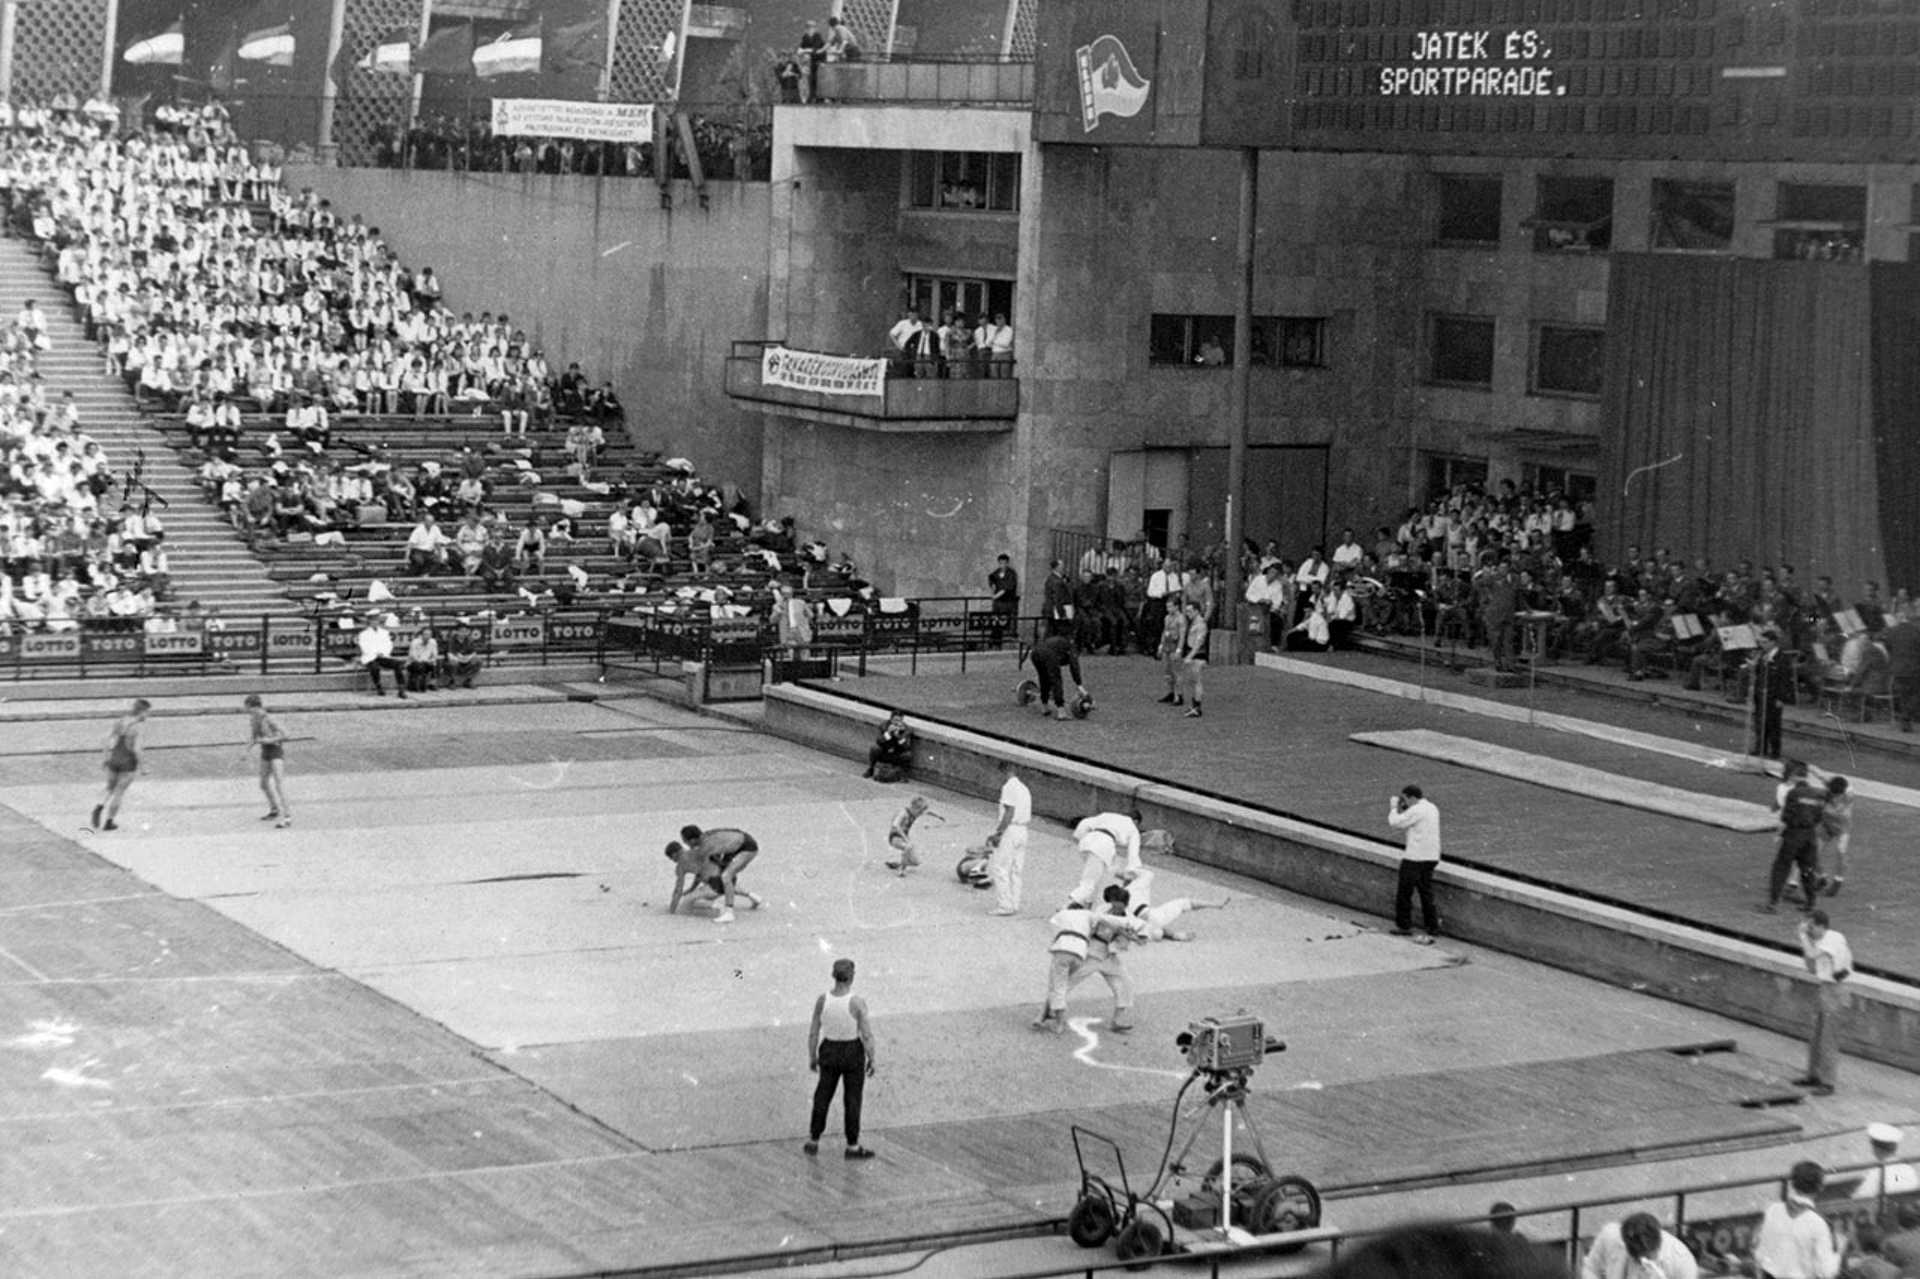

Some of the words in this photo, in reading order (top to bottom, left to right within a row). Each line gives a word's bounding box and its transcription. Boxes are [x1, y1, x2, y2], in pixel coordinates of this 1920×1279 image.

[873, 617, 911, 629] TOTO
[494, 627, 540, 639] LOTTO
[553, 626, 594, 638] TOTO
[25, 639, 76, 652] LOTTO
[91, 638, 136, 651] TOTO
[150, 637, 198, 650] LOTTO
[212, 636, 256, 648] TOTO
[273, 635, 312, 647] LOTTO
